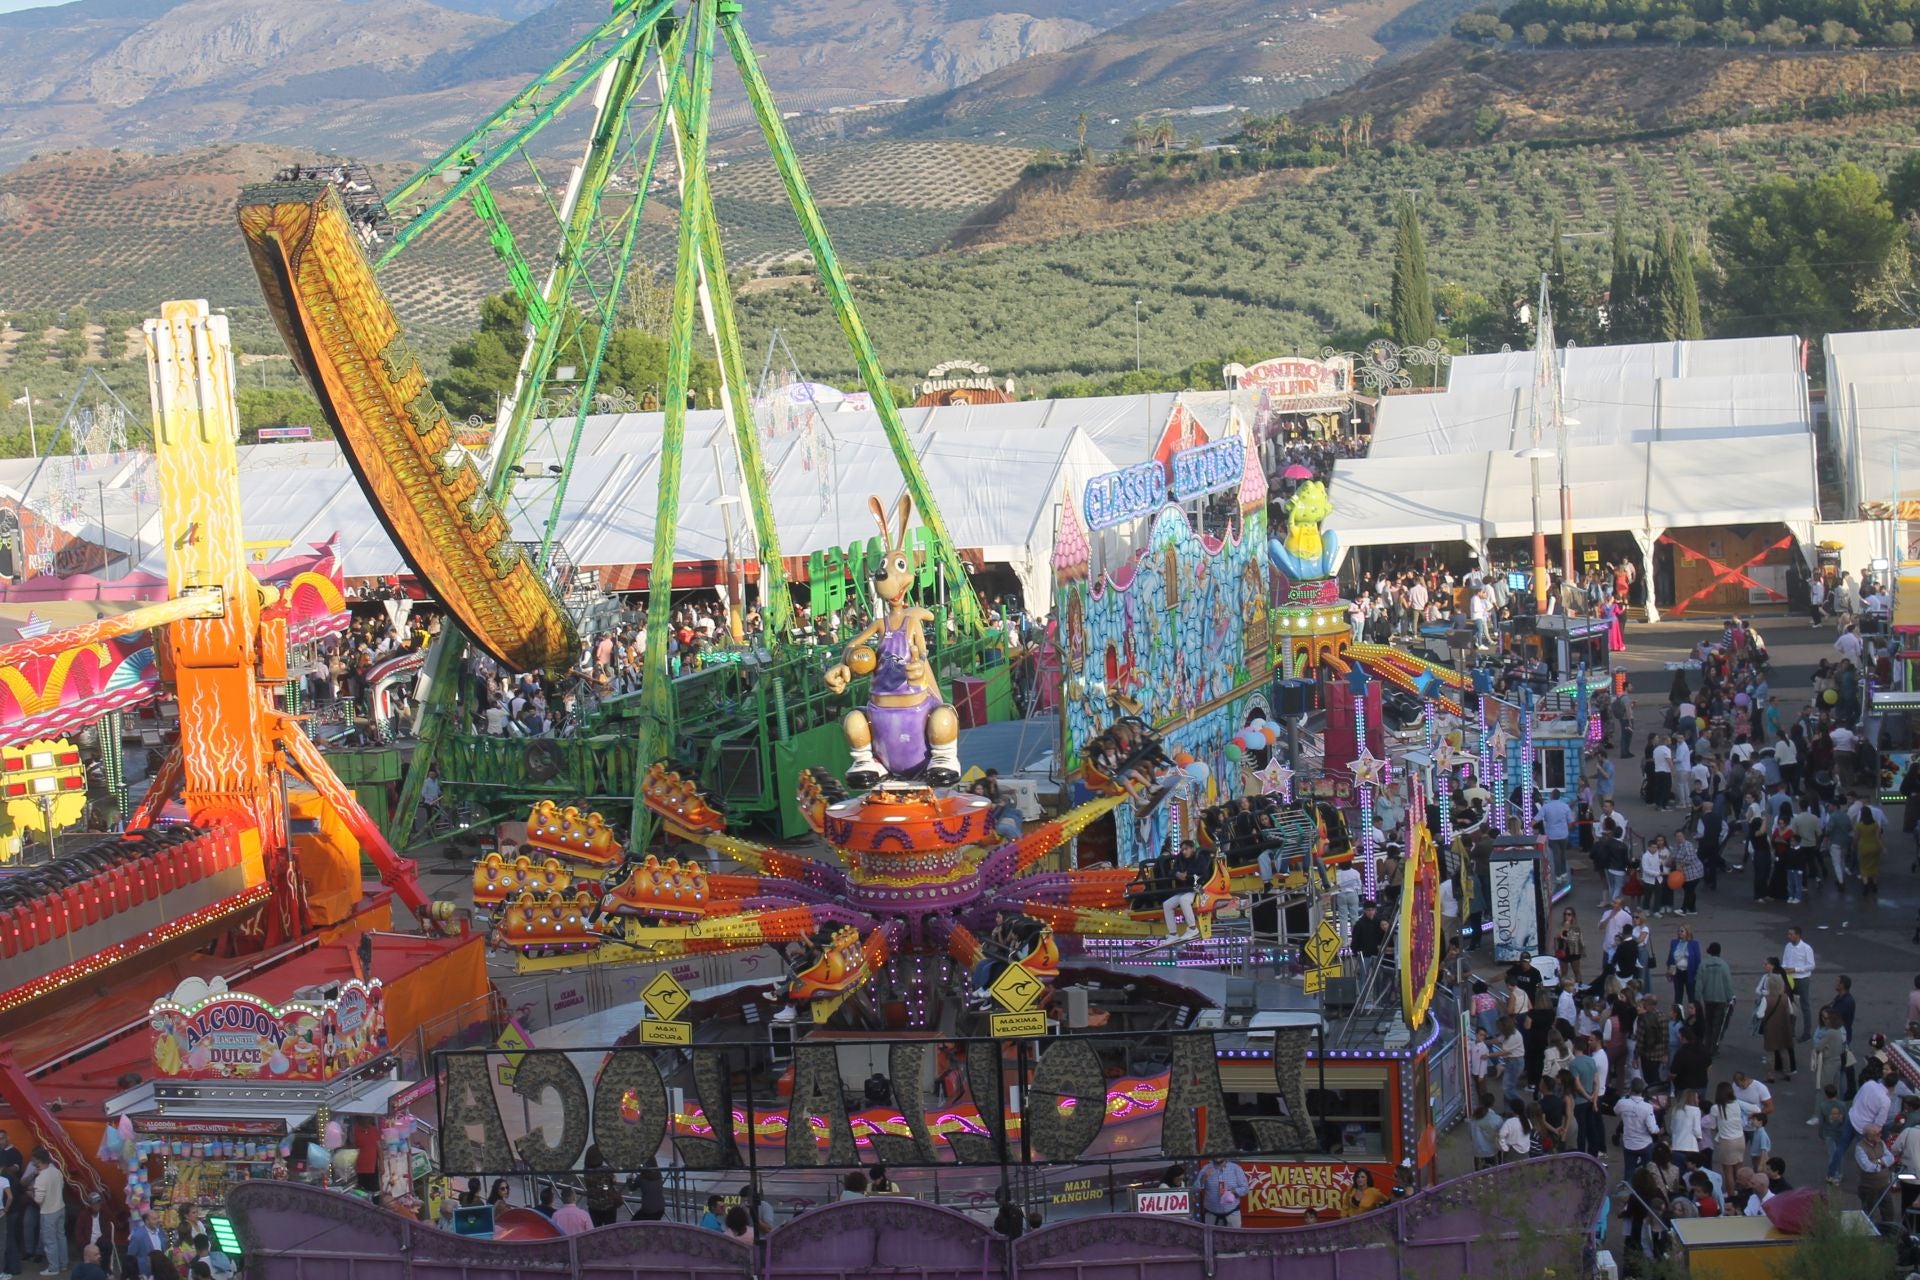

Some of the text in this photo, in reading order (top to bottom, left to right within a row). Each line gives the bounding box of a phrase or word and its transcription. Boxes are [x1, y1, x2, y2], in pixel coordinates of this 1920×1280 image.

[928, 360, 990, 377] BODEGAS
[922, 377, 995, 395] QUINTANA
[1178, 444, 1241, 491] EXPRESS
[186, 1004, 287, 1050] ALGODON
[996, 1024, 1043, 1033] VELOCIDAD
[649, 1032, 683, 1041] LOCURA
[210, 1049, 262, 1064] DULCE
[1270, 1165, 1333, 1185] MAXI
[1065, 1180, 1091, 1192] MAXI
[720, 1194, 742, 1205] AXI
[1053, 1189, 1104, 1205] KANGURO
[1139, 1194, 1188, 1212] SALIDA
[1248, 1187, 1345, 1213] KANGUR
